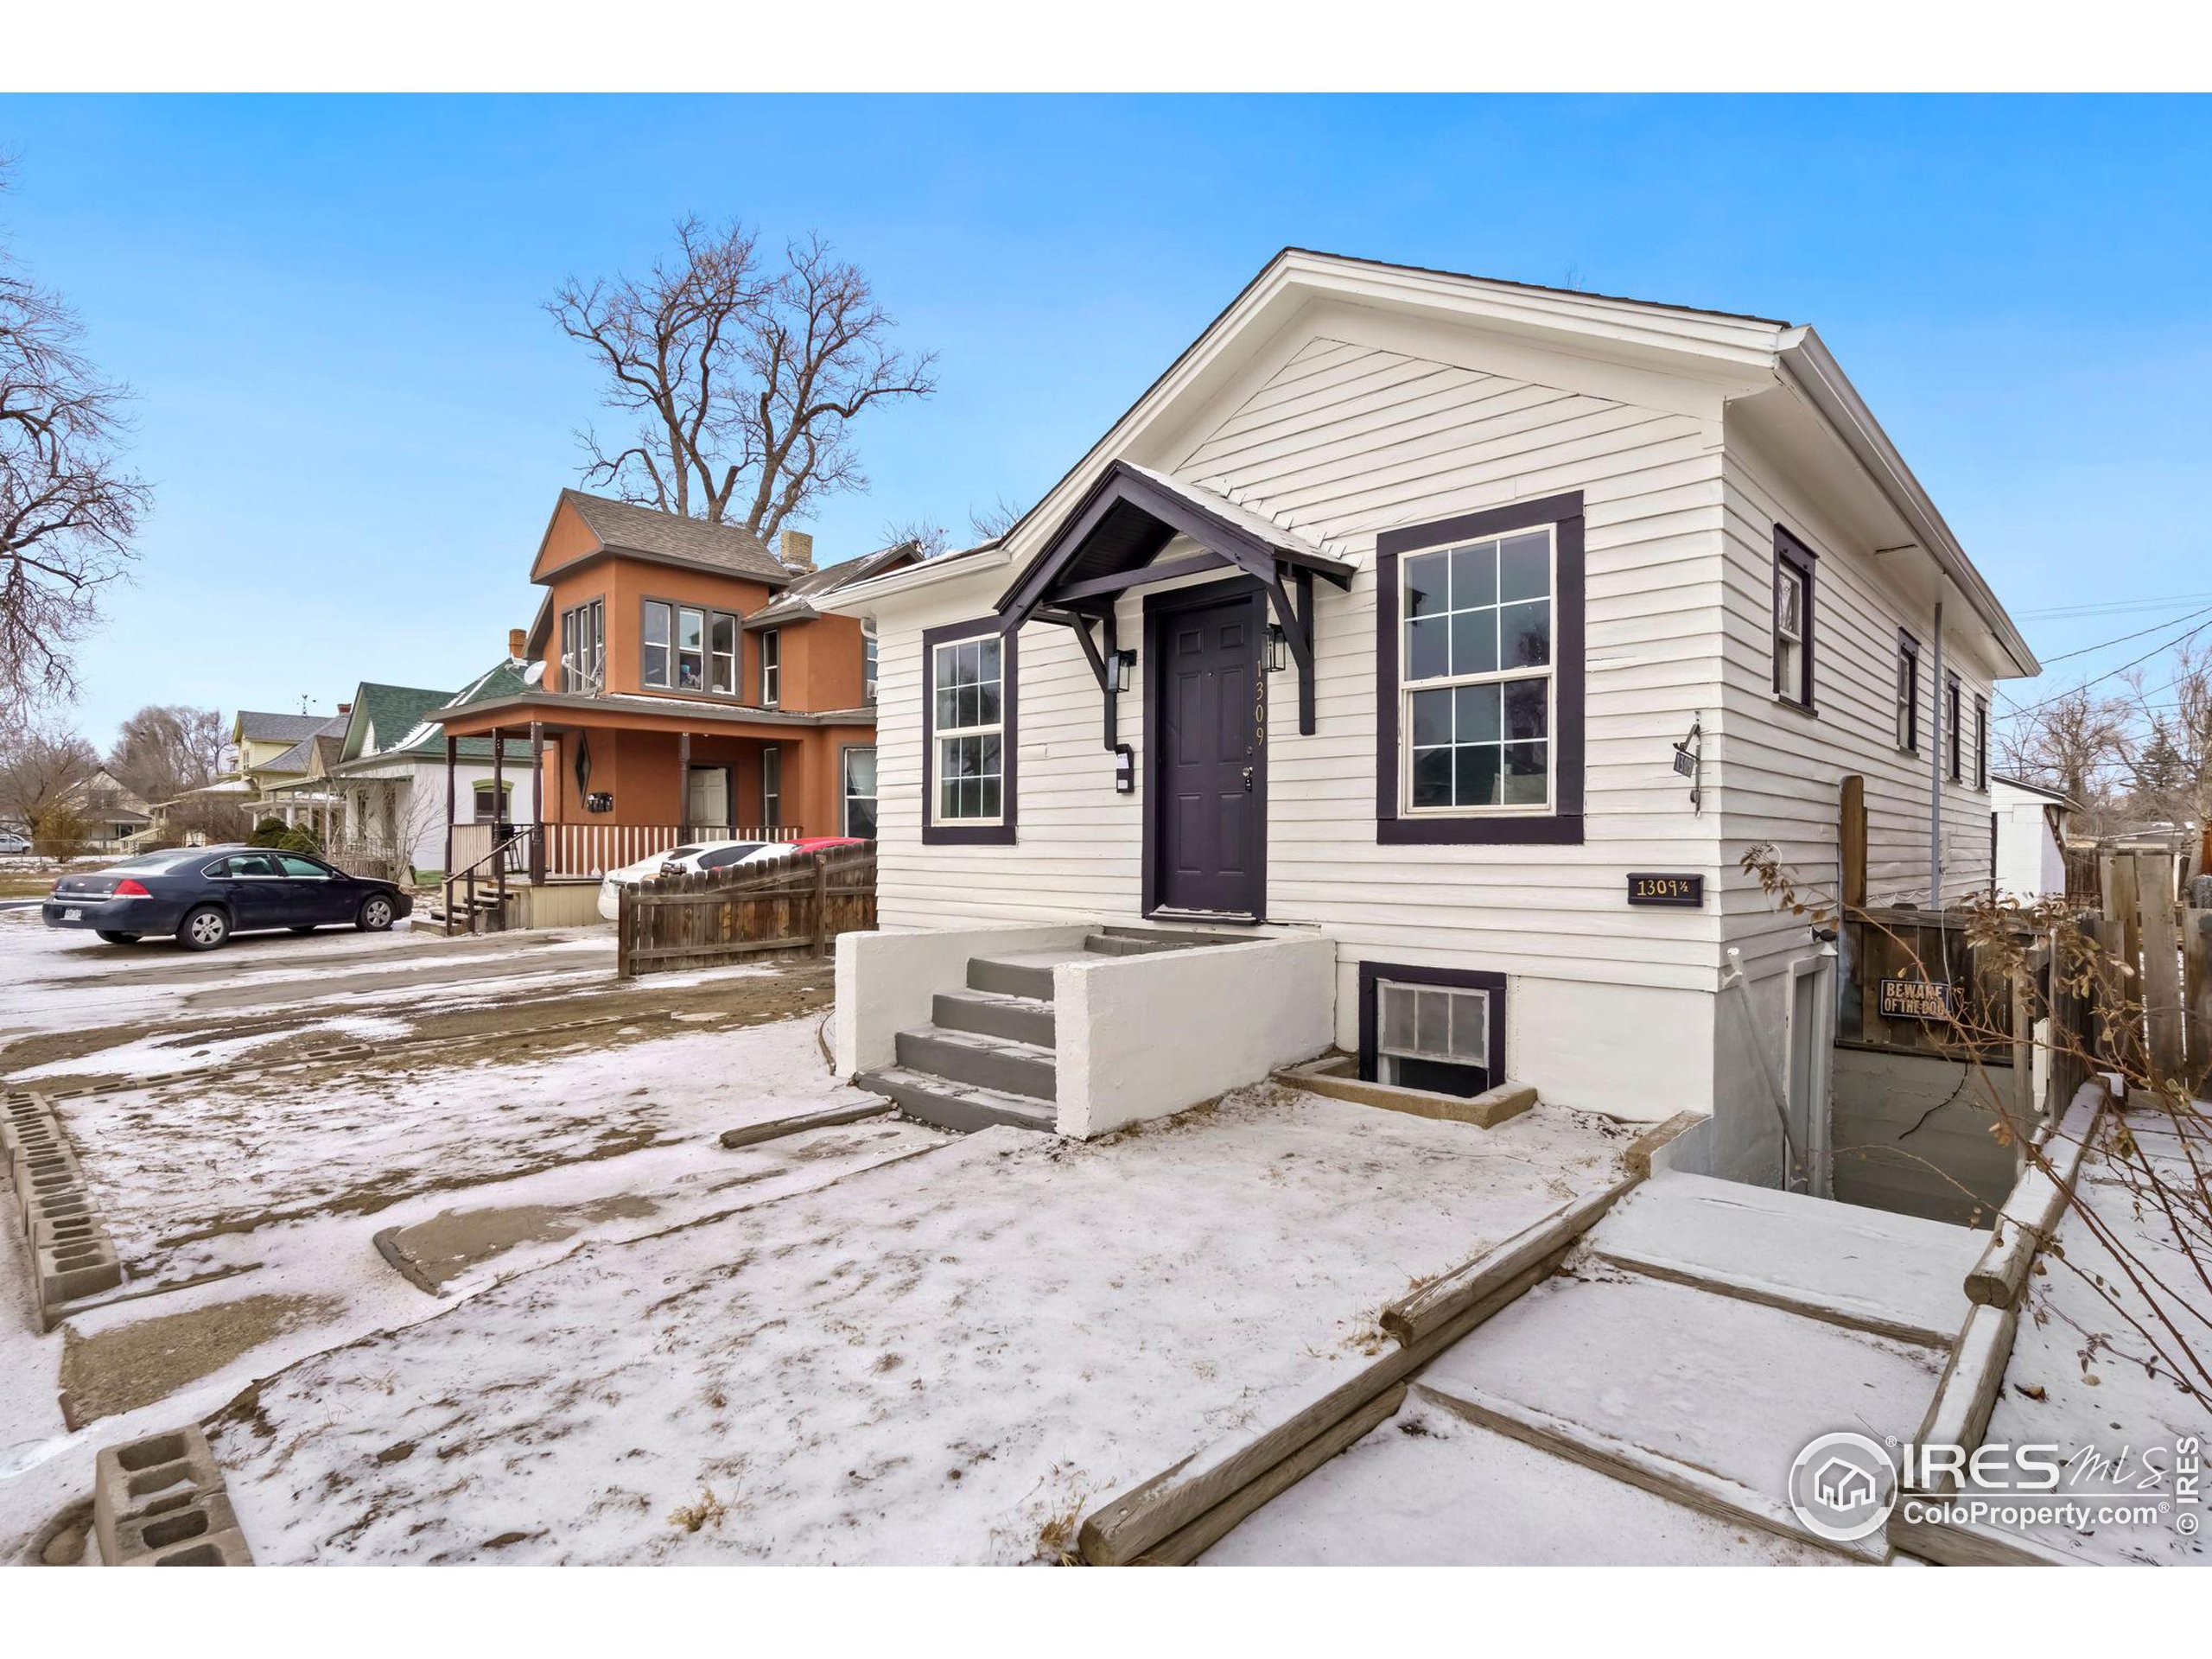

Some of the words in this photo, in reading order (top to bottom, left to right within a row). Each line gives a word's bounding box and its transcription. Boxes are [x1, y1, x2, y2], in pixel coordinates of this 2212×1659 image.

[1886, 982, 1943, 1000] BEWARE
[1885, 998, 1897, 1012] OF
[1901, 1000, 1920, 1014] THE
